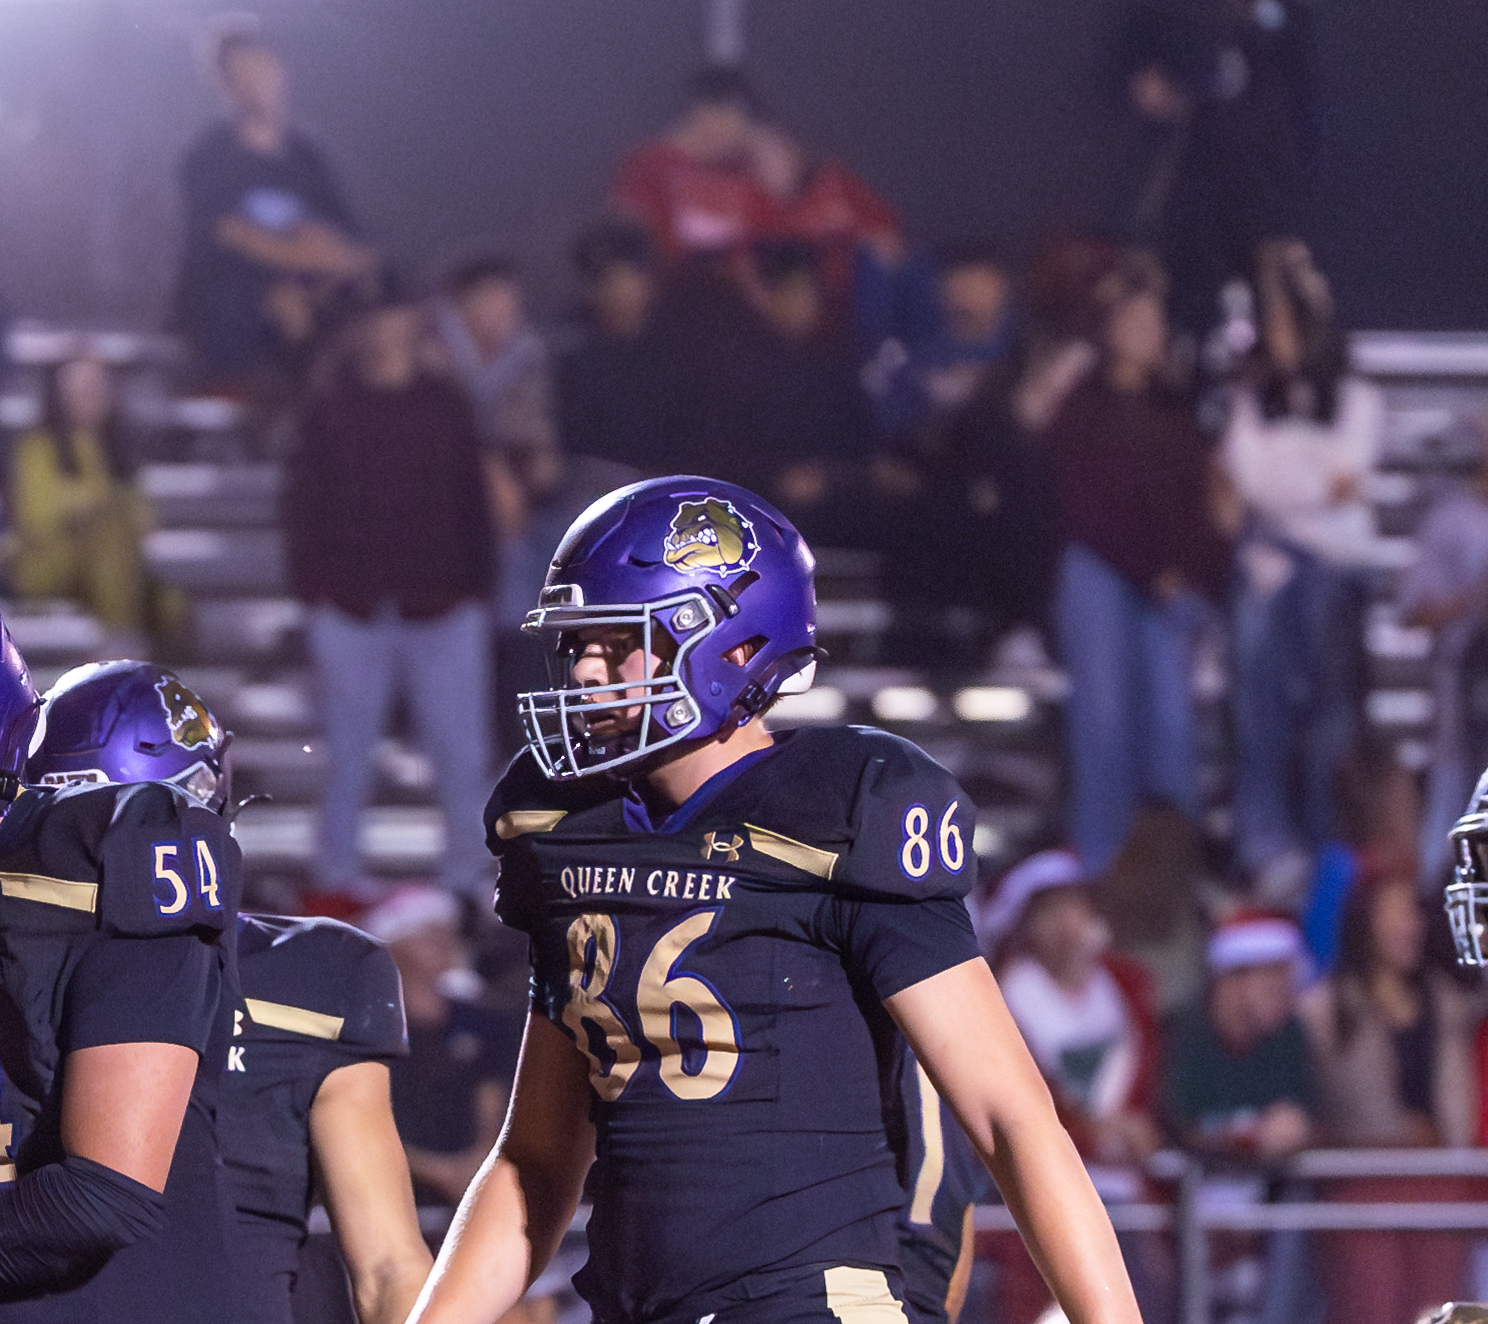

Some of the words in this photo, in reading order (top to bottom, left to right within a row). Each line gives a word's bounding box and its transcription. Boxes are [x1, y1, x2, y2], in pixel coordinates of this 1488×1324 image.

[154, 840, 220, 914] 54
[902, 800, 964, 878] 86
[560, 866, 636, 899] QUEEN
[646, 869, 737, 901] CREEK
[561, 911, 741, 1103] 86
